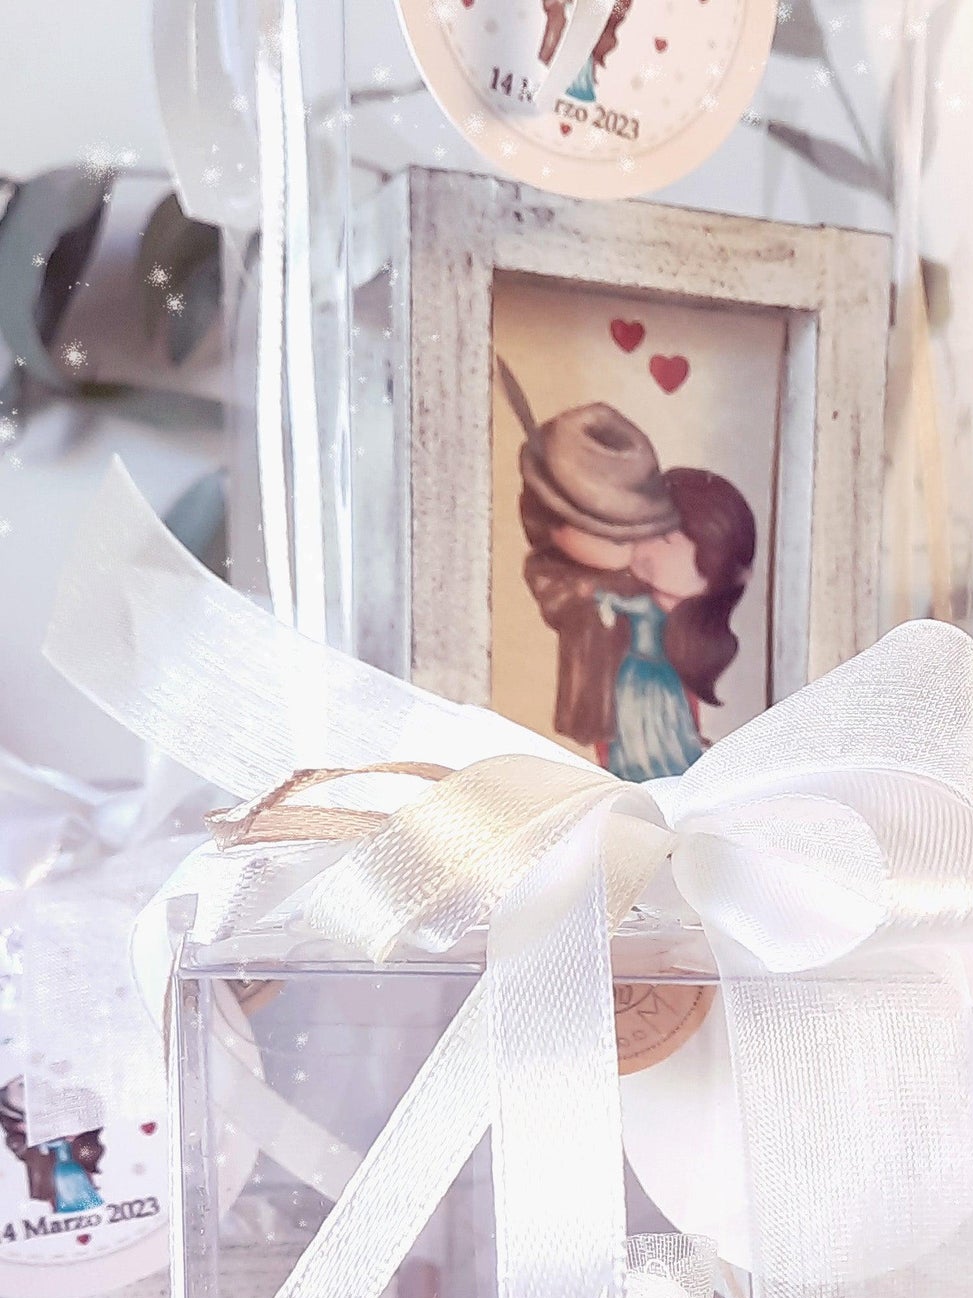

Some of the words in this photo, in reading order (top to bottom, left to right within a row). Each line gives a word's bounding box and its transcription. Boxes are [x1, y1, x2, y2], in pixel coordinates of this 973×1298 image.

[490, 66, 514, 96] 14
[592, 104, 640, 140] 2023
[22, 1214, 102, 1241] Marzo
[106, 1196, 161, 1223] 2023
